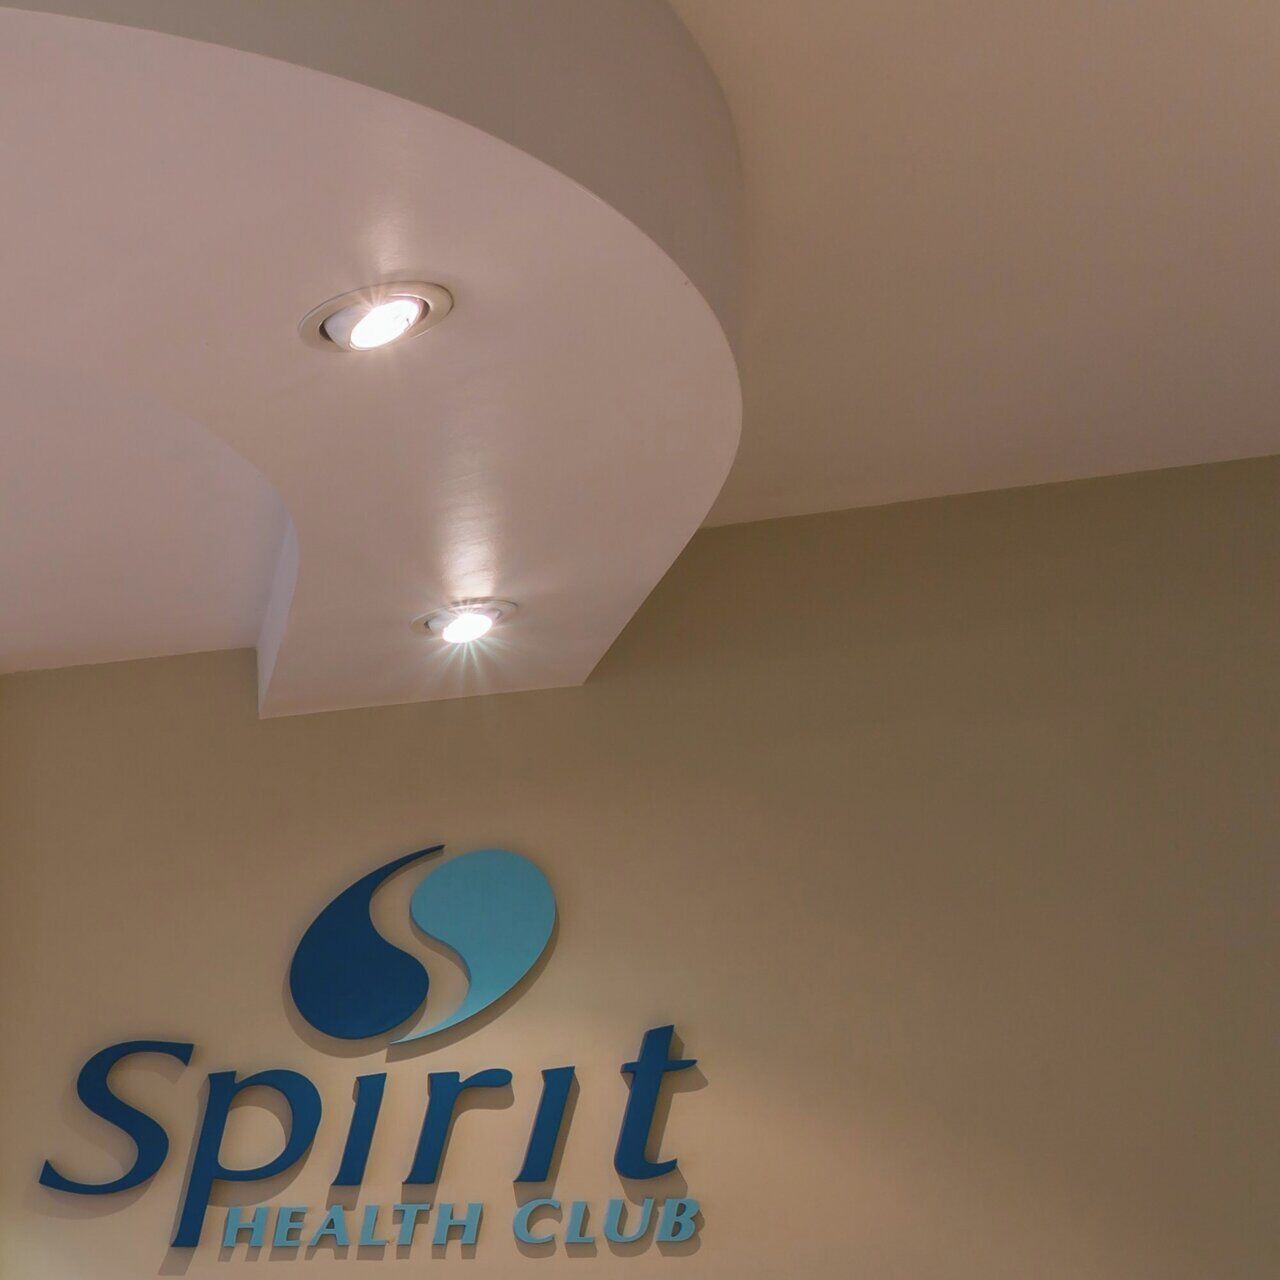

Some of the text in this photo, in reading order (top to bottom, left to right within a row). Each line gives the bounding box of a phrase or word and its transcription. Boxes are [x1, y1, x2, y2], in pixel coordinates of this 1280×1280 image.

[38, 1024, 697, 1248] Spirit
[222, 1198, 701, 1248] HEALTH CLUB
